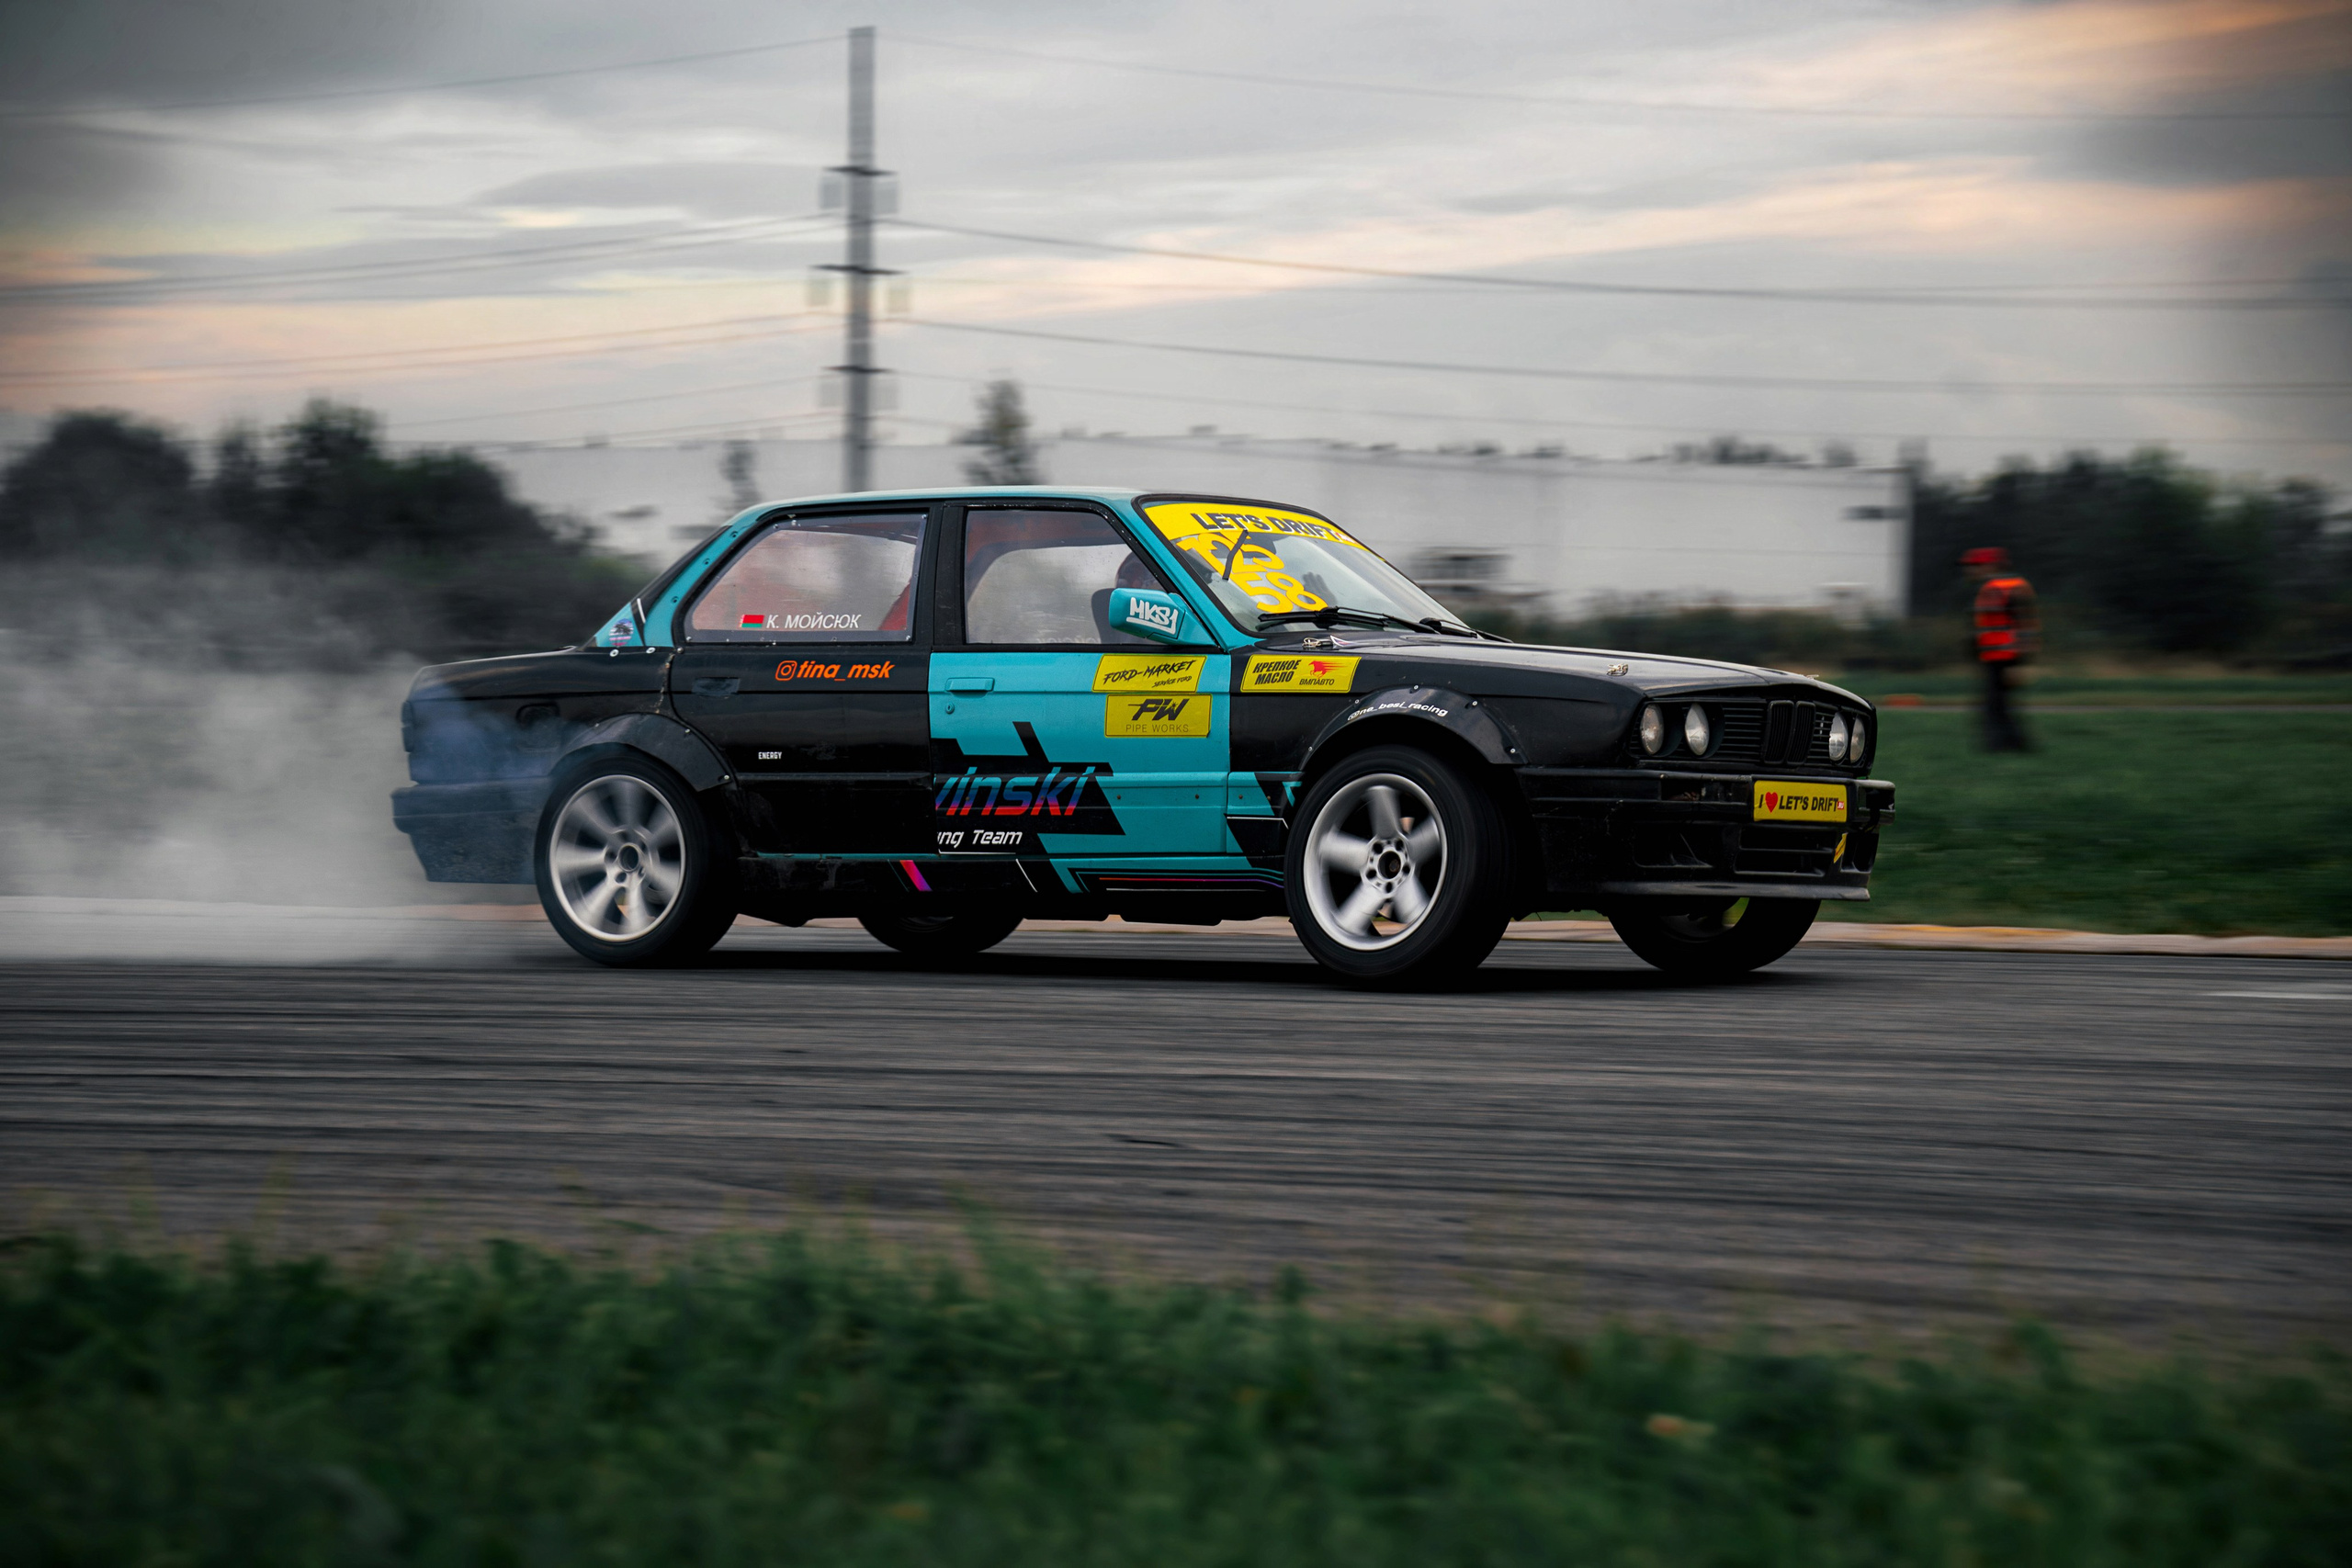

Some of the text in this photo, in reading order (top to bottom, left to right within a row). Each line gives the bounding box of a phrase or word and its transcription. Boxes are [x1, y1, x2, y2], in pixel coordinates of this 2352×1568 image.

[1190, 513, 1273, 532] LET'S
[1266, 516, 1343, 542] DRIFT
[1230, 571, 1329, 614] 58
[766, 612, 862, 628] К. МОЙСЮК
[1103, 660, 1196, 684] FORD-MARKET
[1252, 660, 1302, 673] КРЕПКОЕ
[1152, 675, 1193, 688] SERVICE FORD
[1254, 671, 1295, 685] МАСЛО
[1125, 724, 1189, 733] PIPE WORKS
[758, 751, 782, 760] ENERGY
[1758, 794, 1764, 808] I
[1779, 795, 1809, 810] LET'S
[972, 829, 1023, 845] Team
